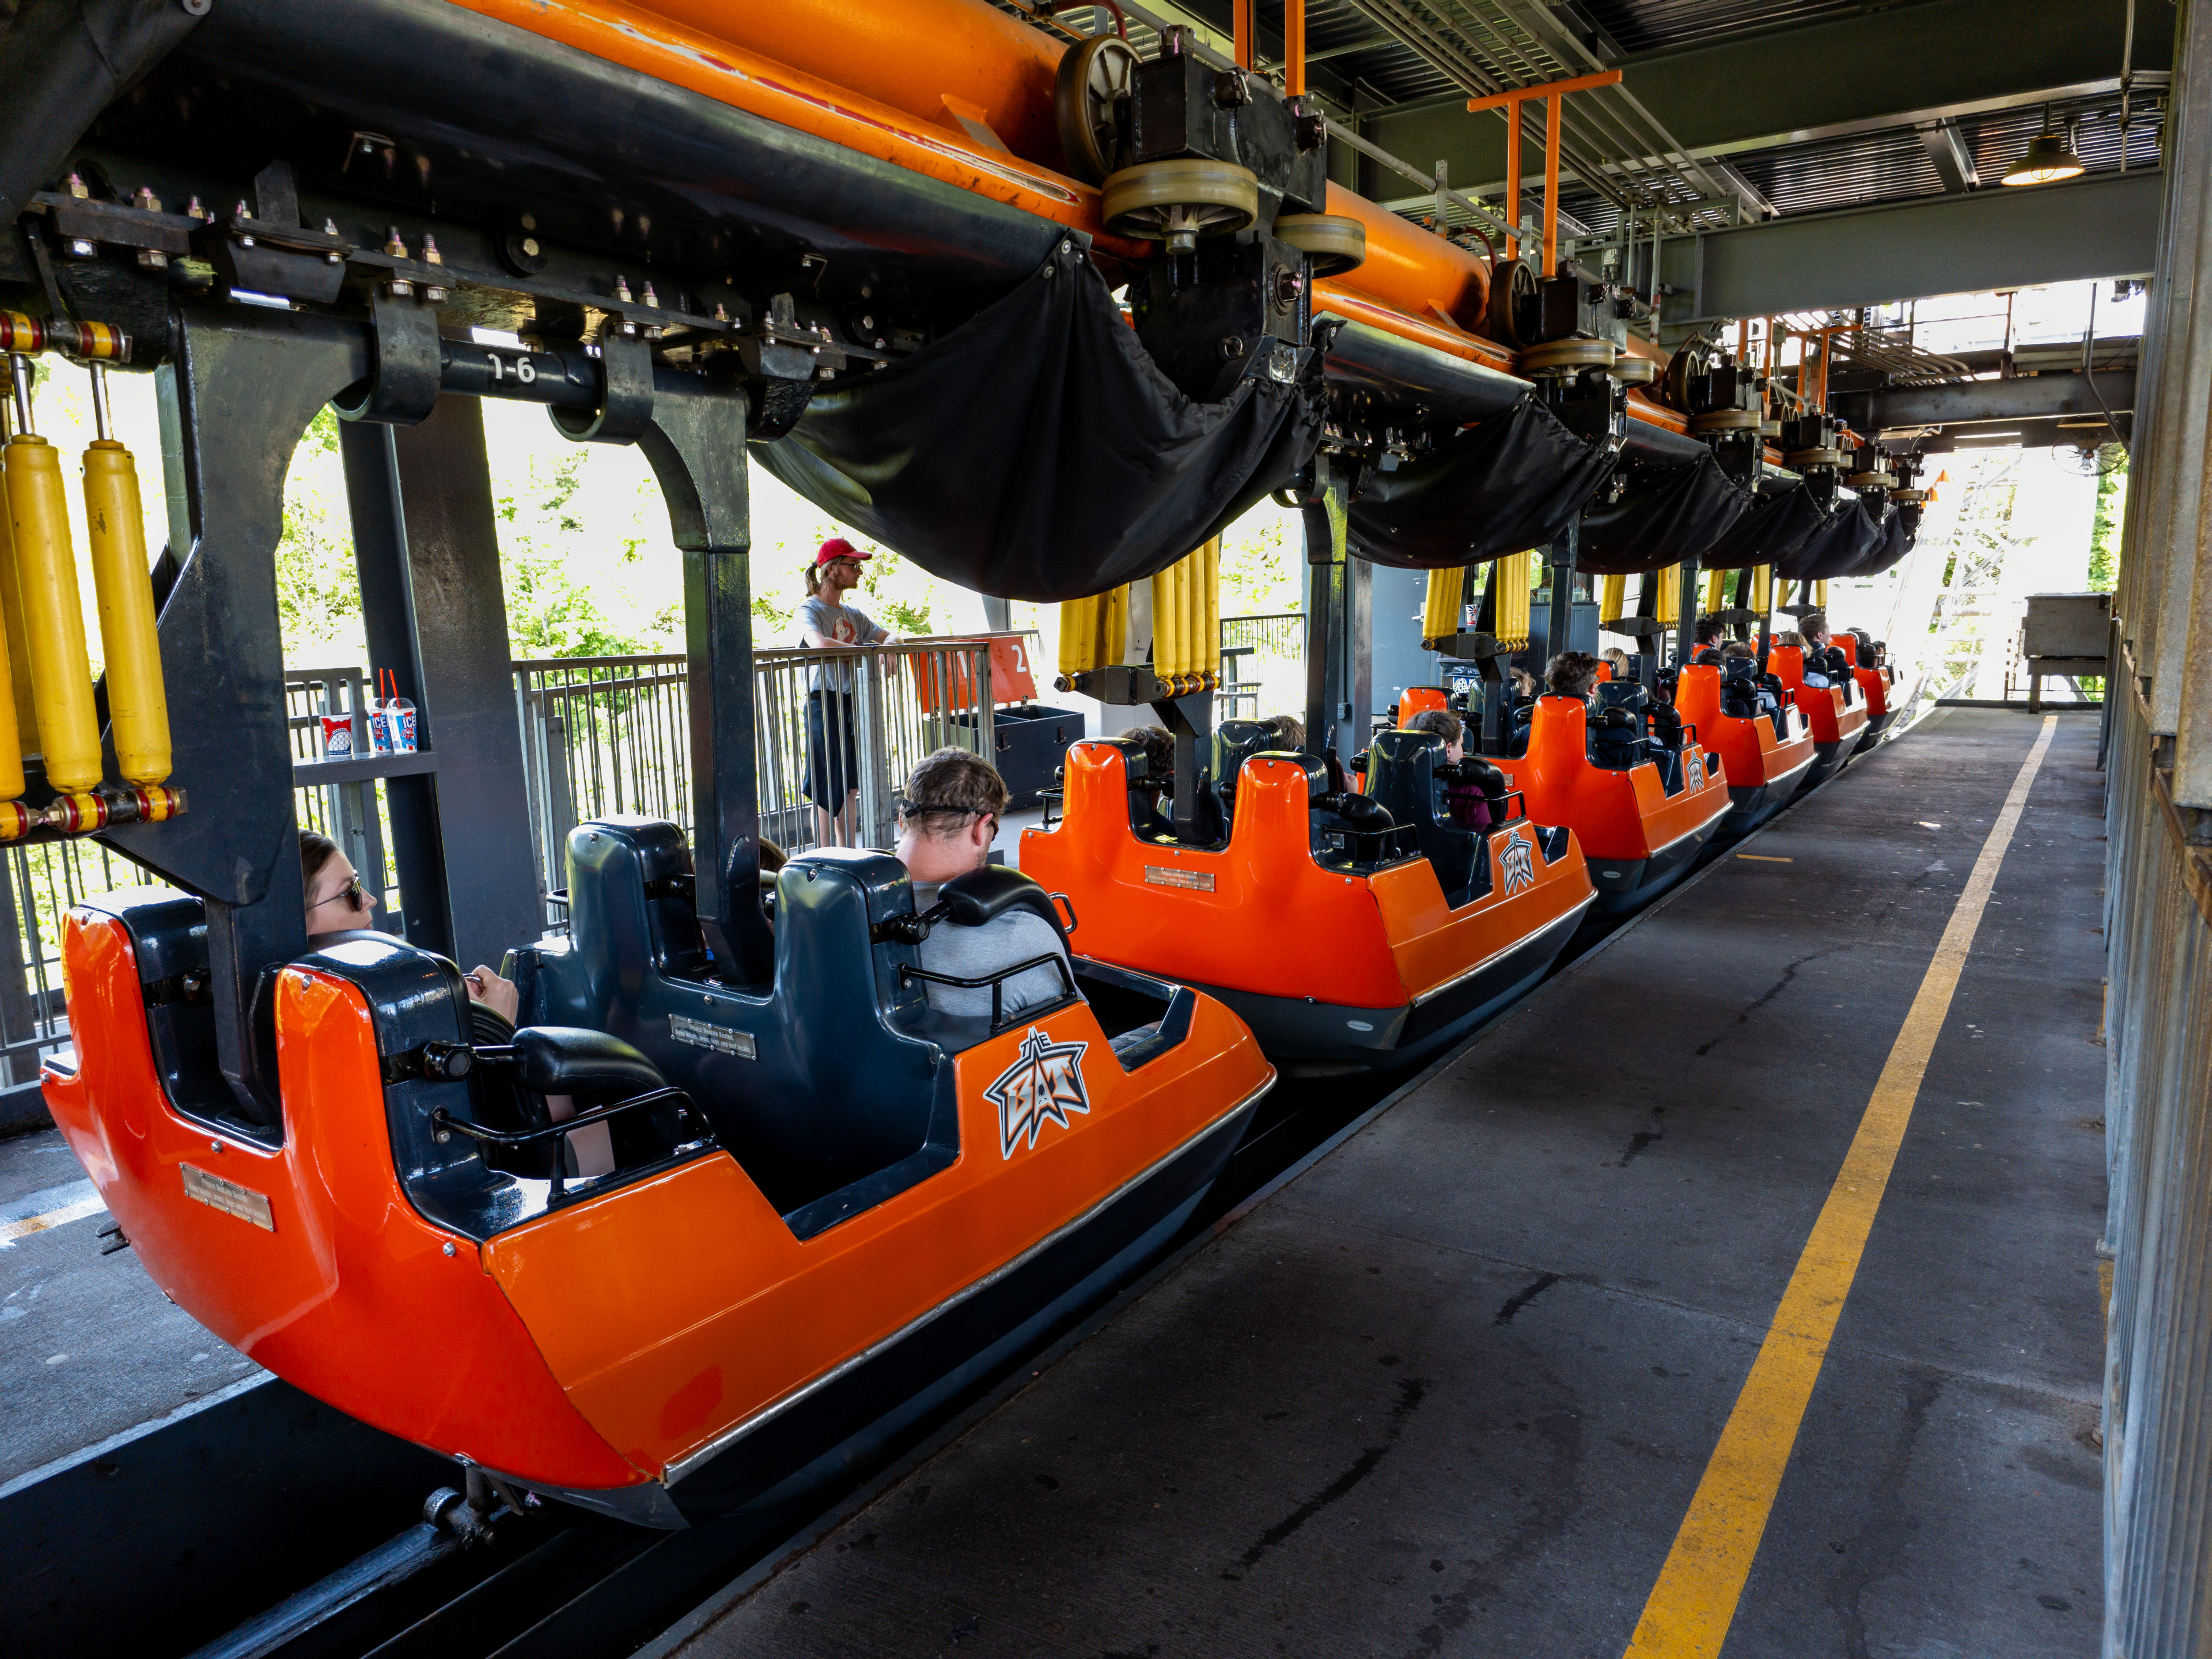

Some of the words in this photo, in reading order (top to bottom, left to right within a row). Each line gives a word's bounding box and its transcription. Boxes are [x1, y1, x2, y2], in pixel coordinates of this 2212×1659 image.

[487, 353, 536, 383] 1-6
[957, 650, 968, 678] 1
[1011, 645, 1027, 673] 2
[675, 1028, 685, 1037] Keep
[699, 1035, 711, 1044] arms,
[711, 1037, 720, 1046] legs
[689, 1024, 703, 1033] Please
[703, 1028, 718, 1037] Remain
[719, 1032, 734, 1041] Seated.
[1021, 1027, 1051, 1058] THE
[1002, 1054, 1082, 1142] BAT
